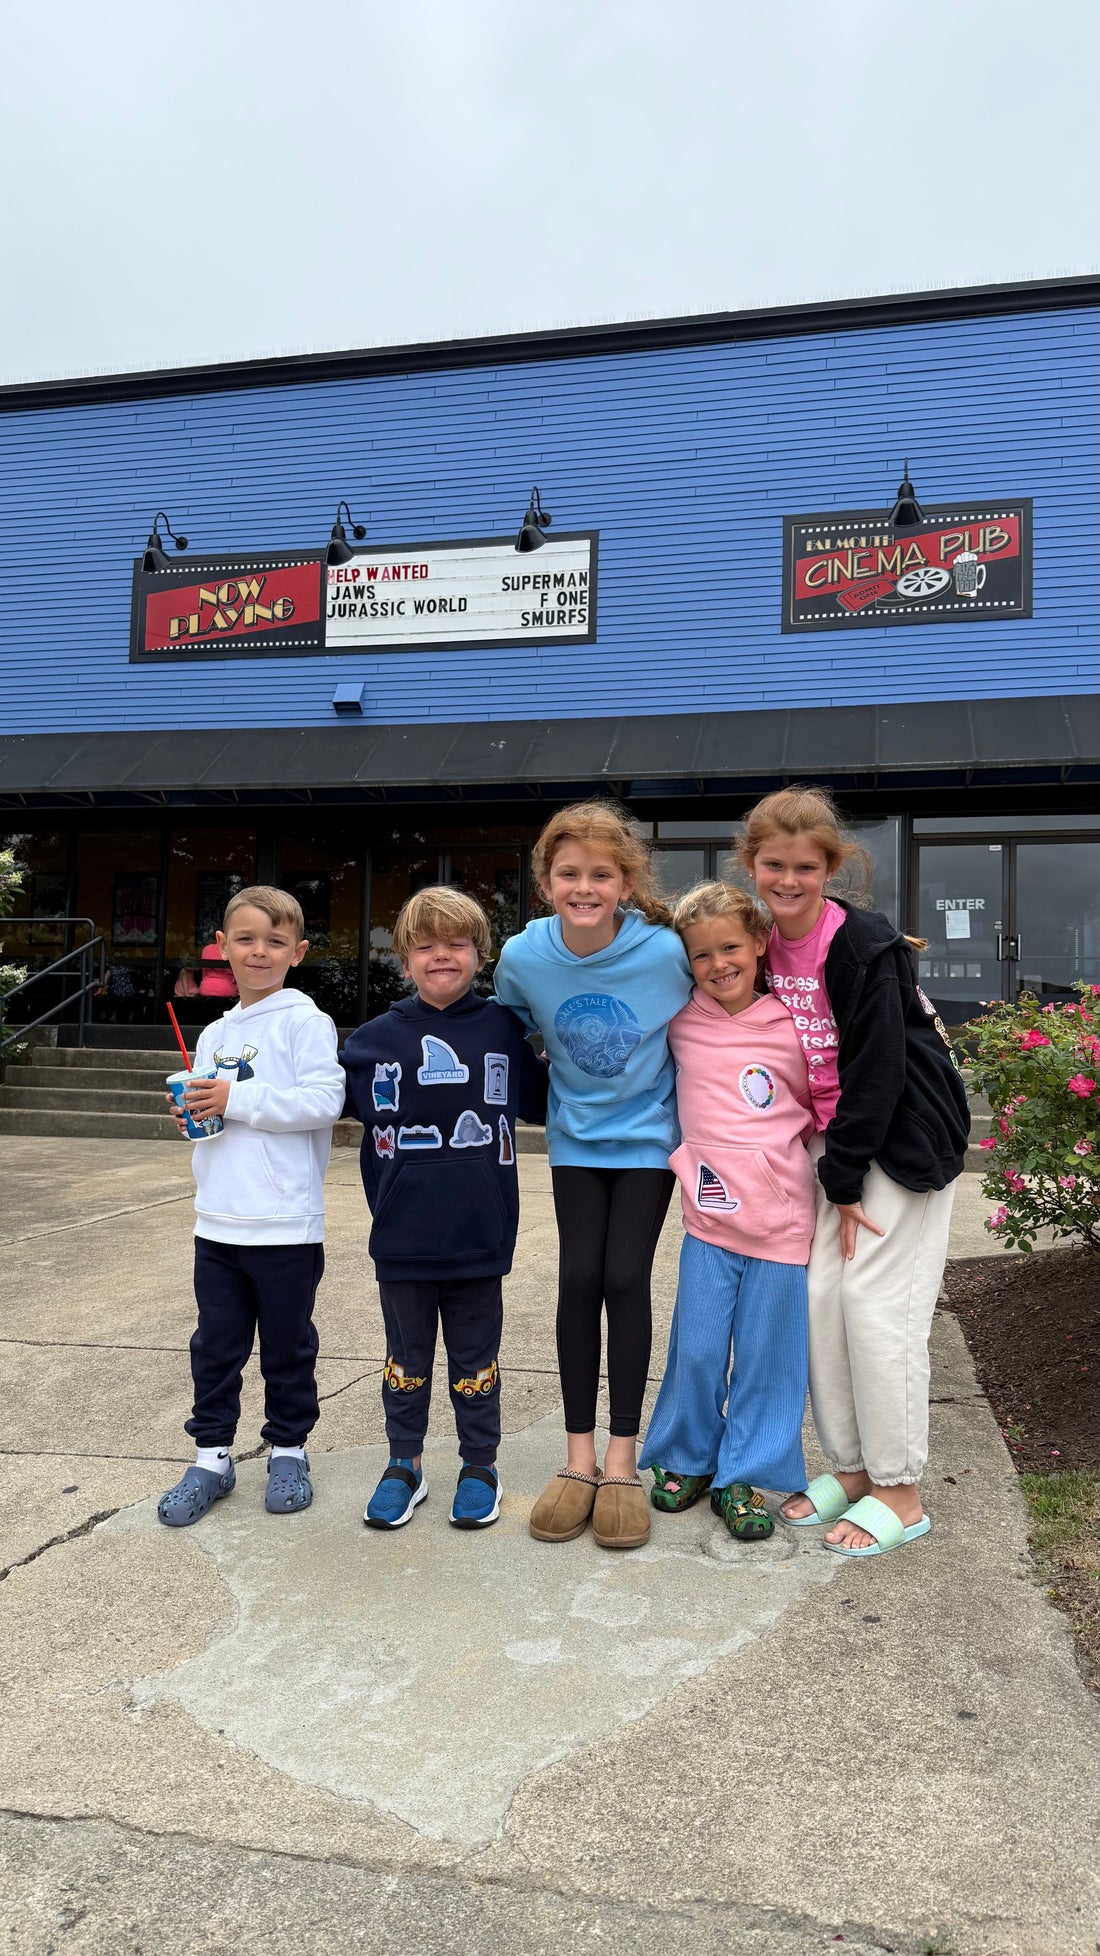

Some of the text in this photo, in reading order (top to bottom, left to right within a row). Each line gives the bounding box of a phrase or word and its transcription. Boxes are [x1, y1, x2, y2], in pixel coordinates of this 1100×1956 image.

[805, 533, 896, 552] FALMOUTH
[804, 524, 1011, 588] CINEMA PUB
[327, 564, 429, 584] HELP WANTED
[501, 572, 588, 591] SUPERMAN
[198, 575, 267, 611] NOW
[331, 585, 376, 601] JAWS
[540, 590, 588, 608] F ONE
[852, 584, 881, 600] ADMIT
[859, 591, 880, 601] ONE
[327, 597, 468, 618] JURASSIC WORLD
[168, 596, 296, 641] PLAYING
[521, 608, 587, 627] SMURFS
[935, 898, 986, 911] ENTER
[583, 997, 607, 1007] TALE
[423, 1070, 464, 1080] VINEYARD
